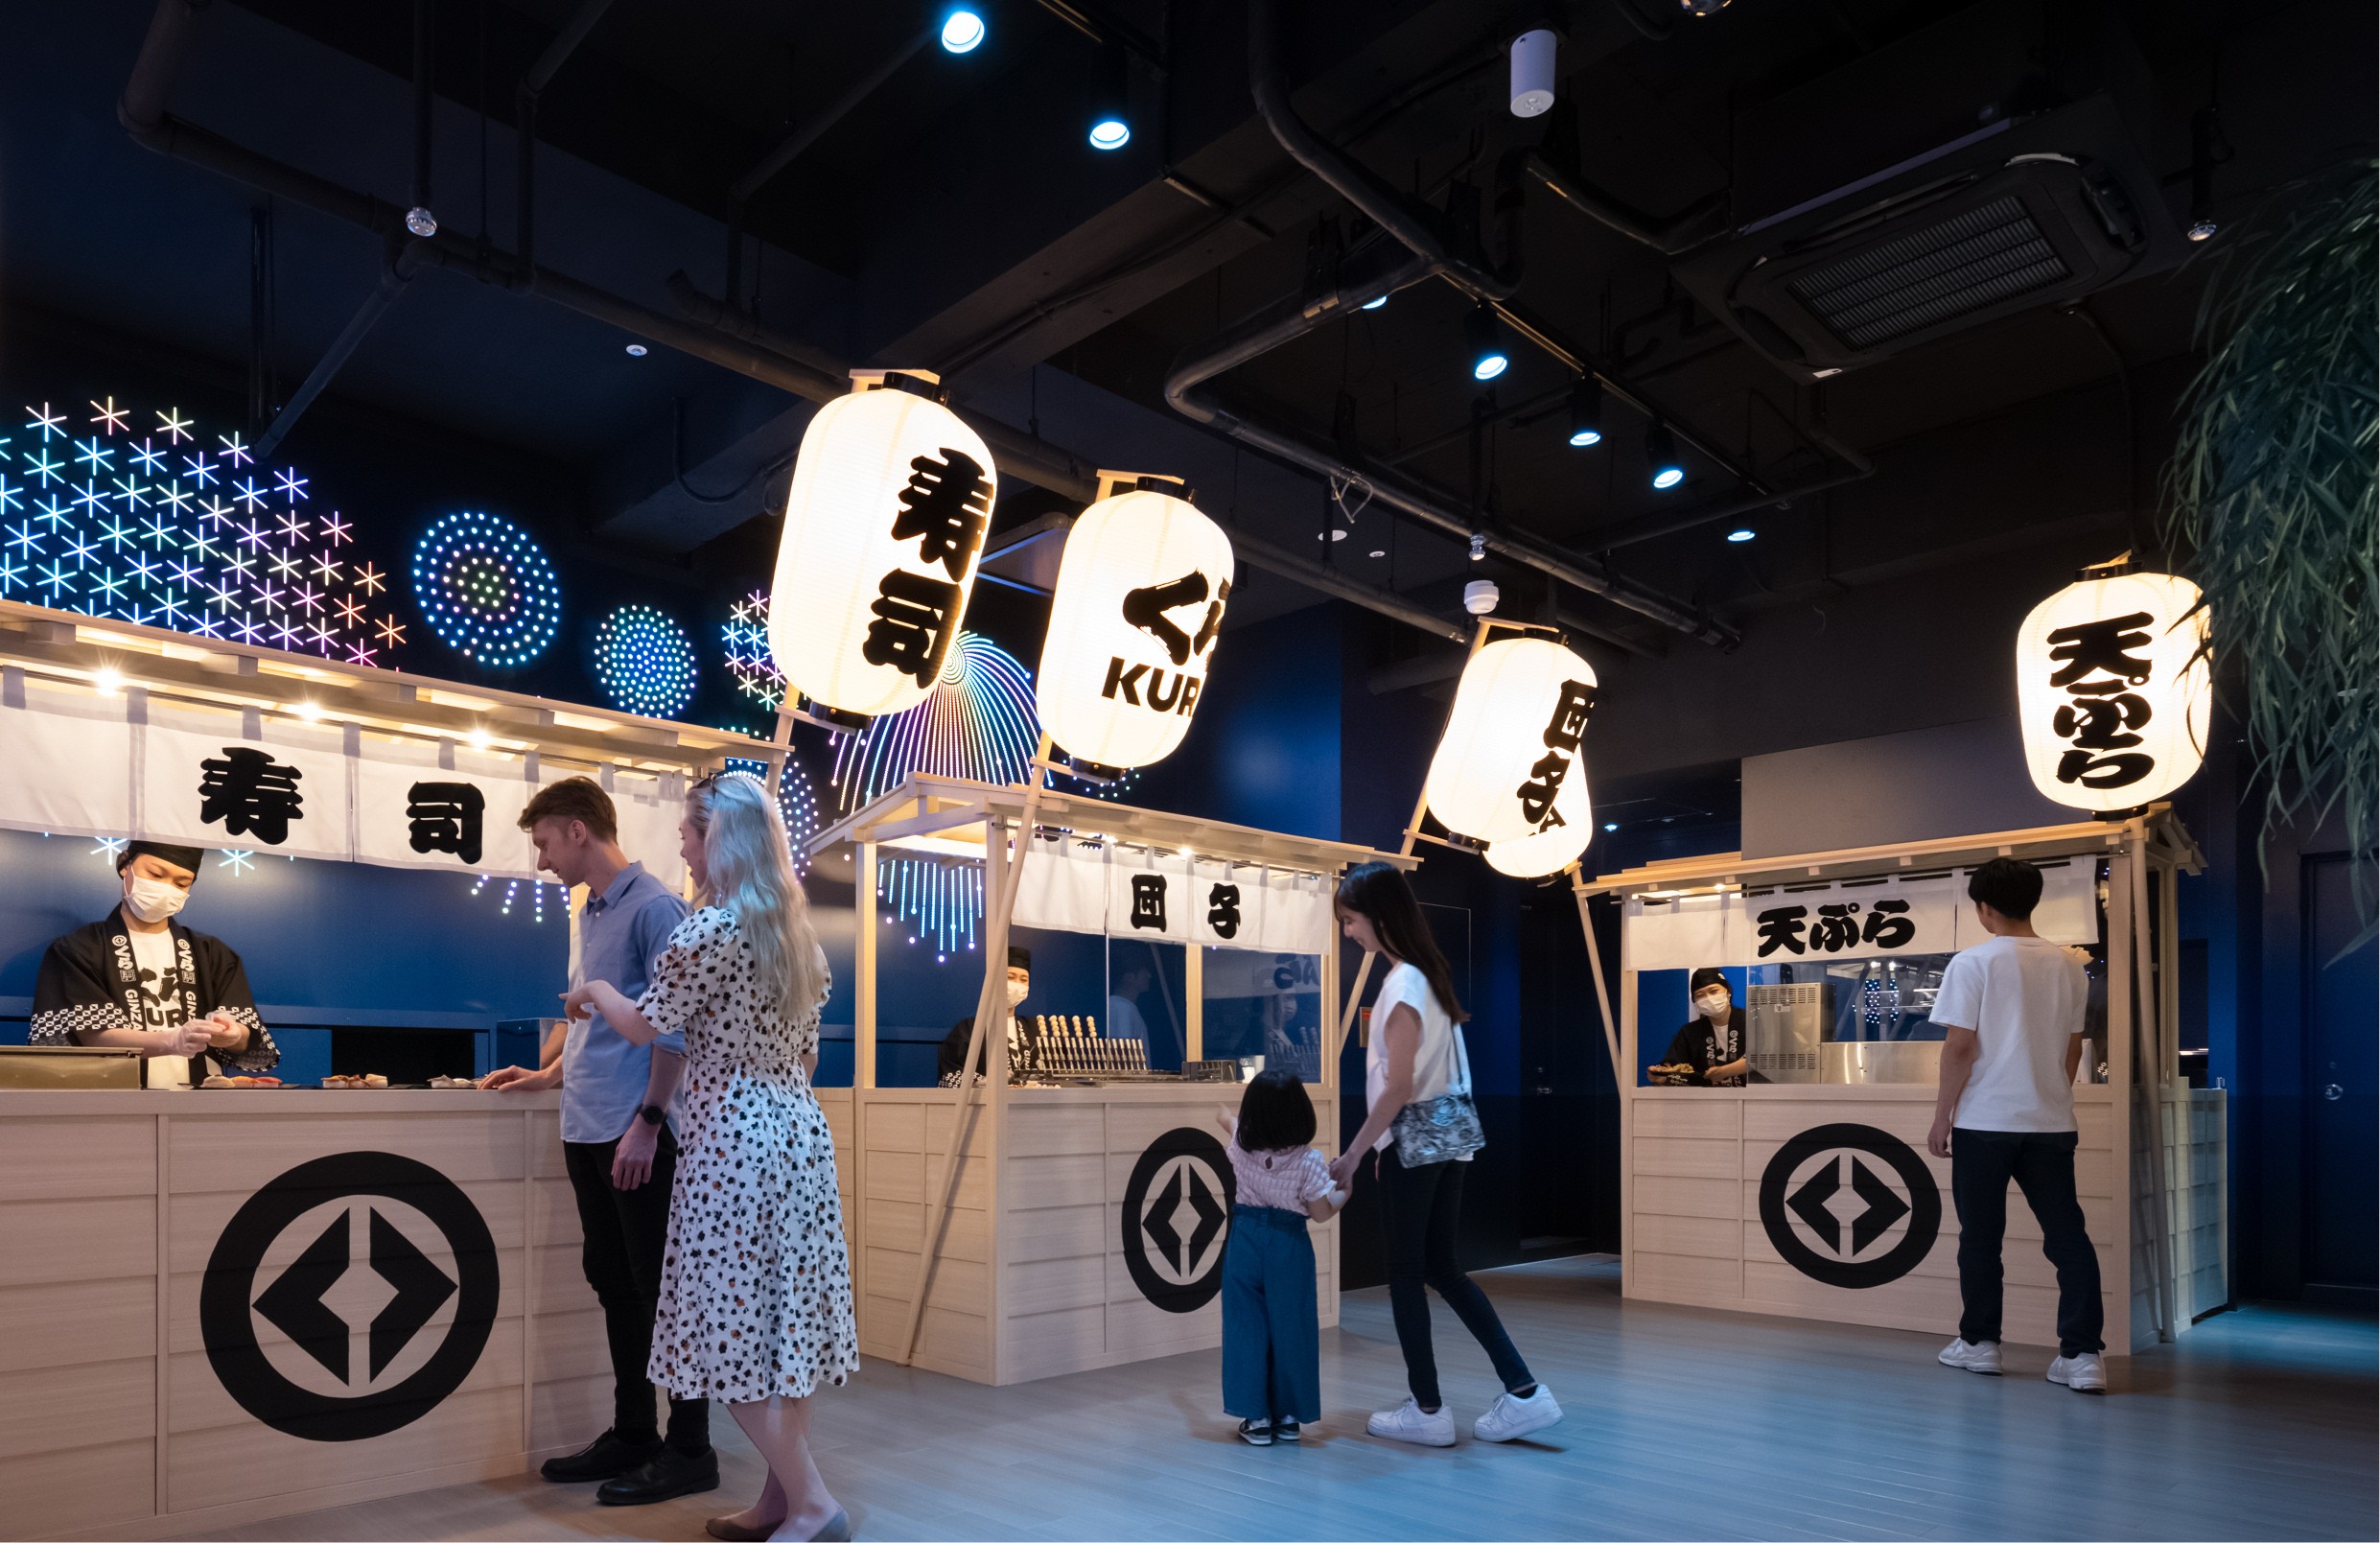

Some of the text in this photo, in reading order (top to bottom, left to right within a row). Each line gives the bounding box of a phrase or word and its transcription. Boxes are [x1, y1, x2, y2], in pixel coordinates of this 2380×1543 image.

[863, 447, 994, 689] 寿司
[1101, 656, 1201, 717] KUR
[2046, 611, 2155, 789] 天ぷら
[1757, 900, 1916, 957] 天ぷら
